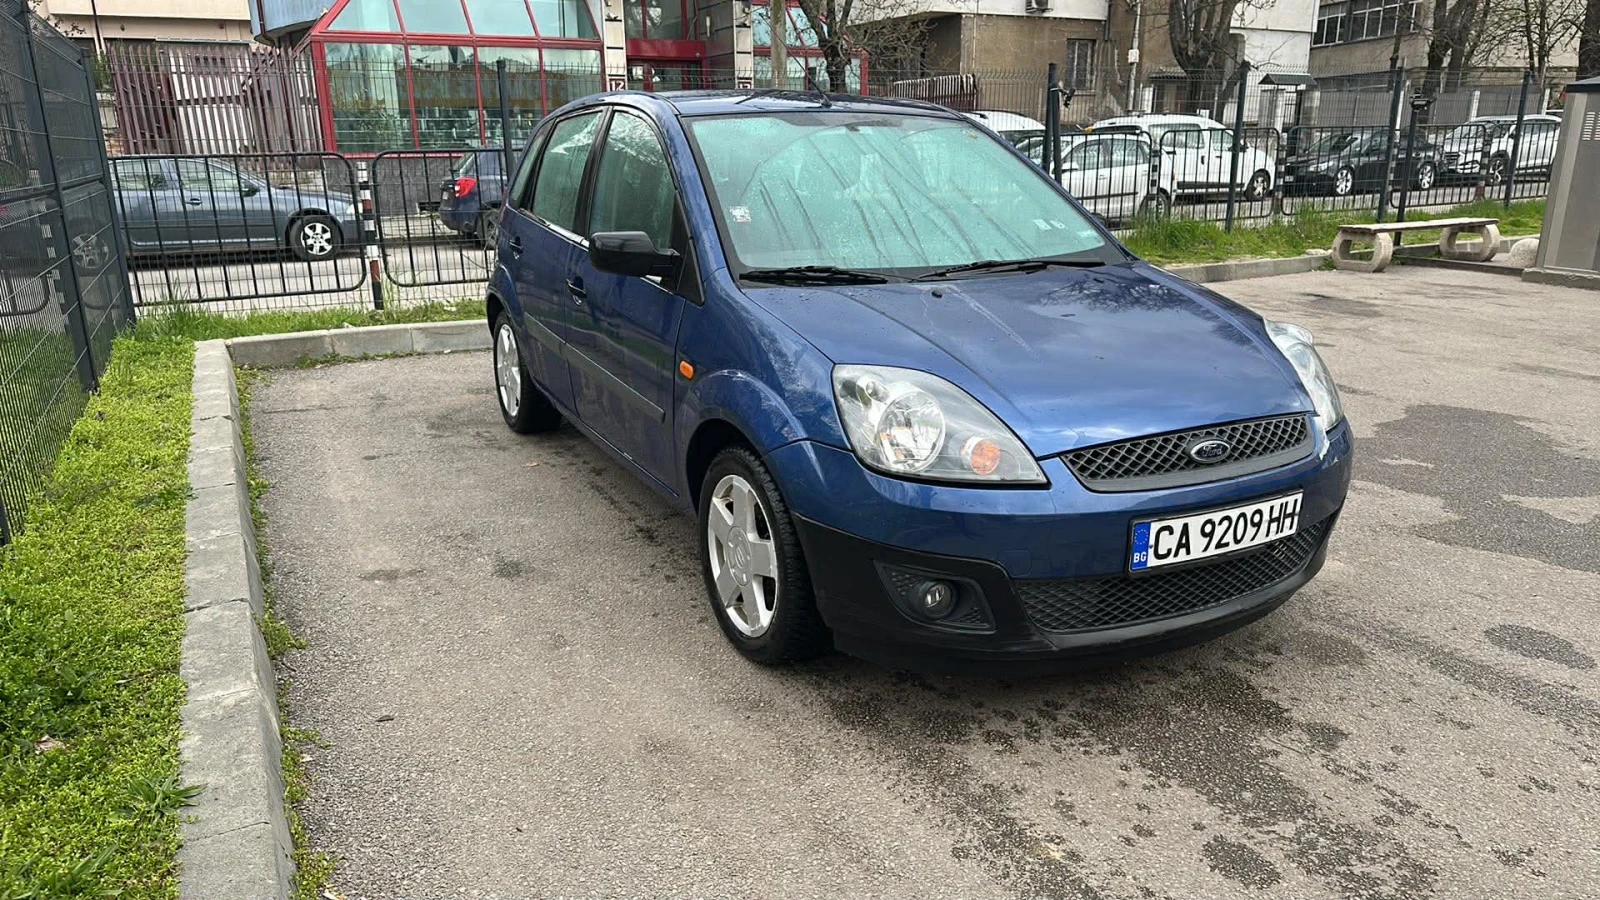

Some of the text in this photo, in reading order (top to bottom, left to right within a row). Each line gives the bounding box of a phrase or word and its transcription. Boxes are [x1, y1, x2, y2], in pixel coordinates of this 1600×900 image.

[610, 80, 625, 91] 12
[1202, 444, 1223, 456] Ford
[1153, 499, 1298, 560] CA 9209 HH
[1133, 553, 1147, 563] BG
